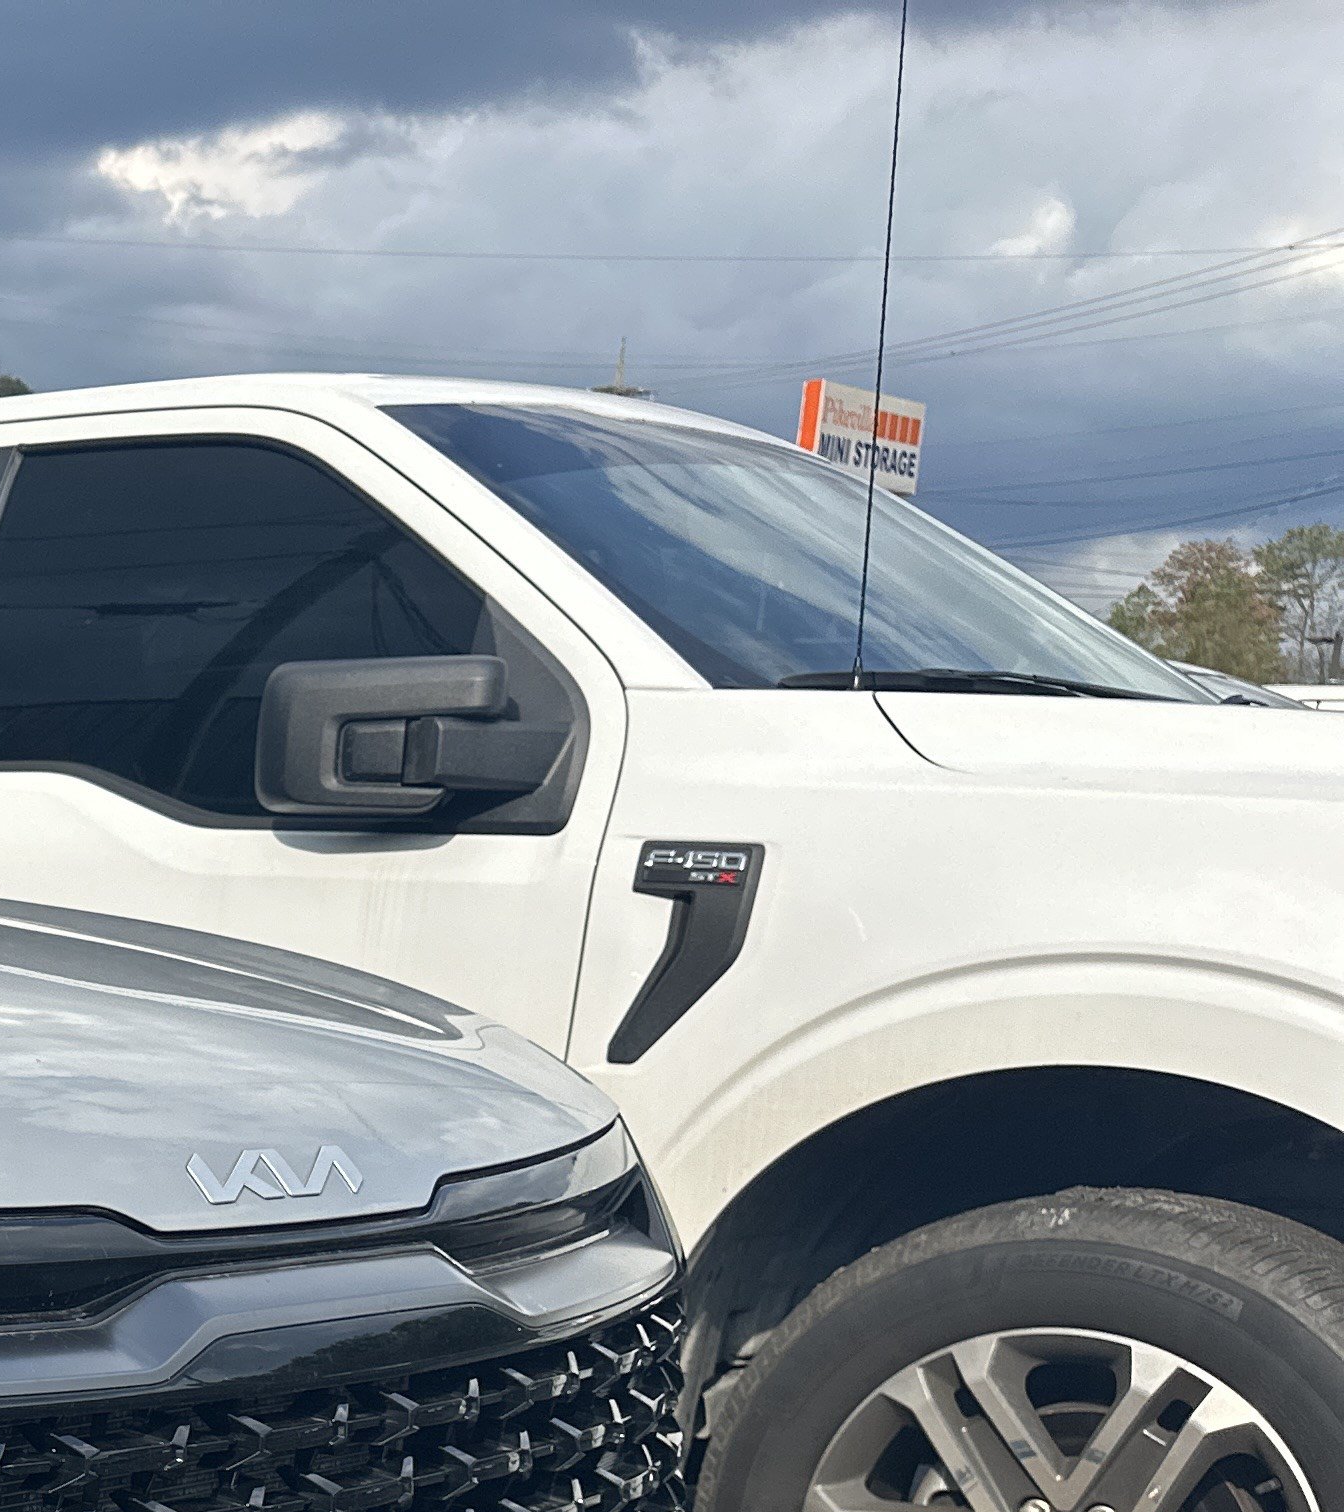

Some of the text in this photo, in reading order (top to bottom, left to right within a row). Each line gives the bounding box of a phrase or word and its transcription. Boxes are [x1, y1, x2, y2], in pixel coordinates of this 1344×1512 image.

[818, 432, 917, 479] MINI STORAGE
[643, 849, 748, 872] F-150
[185, 1144, 365, 1206] KIA
